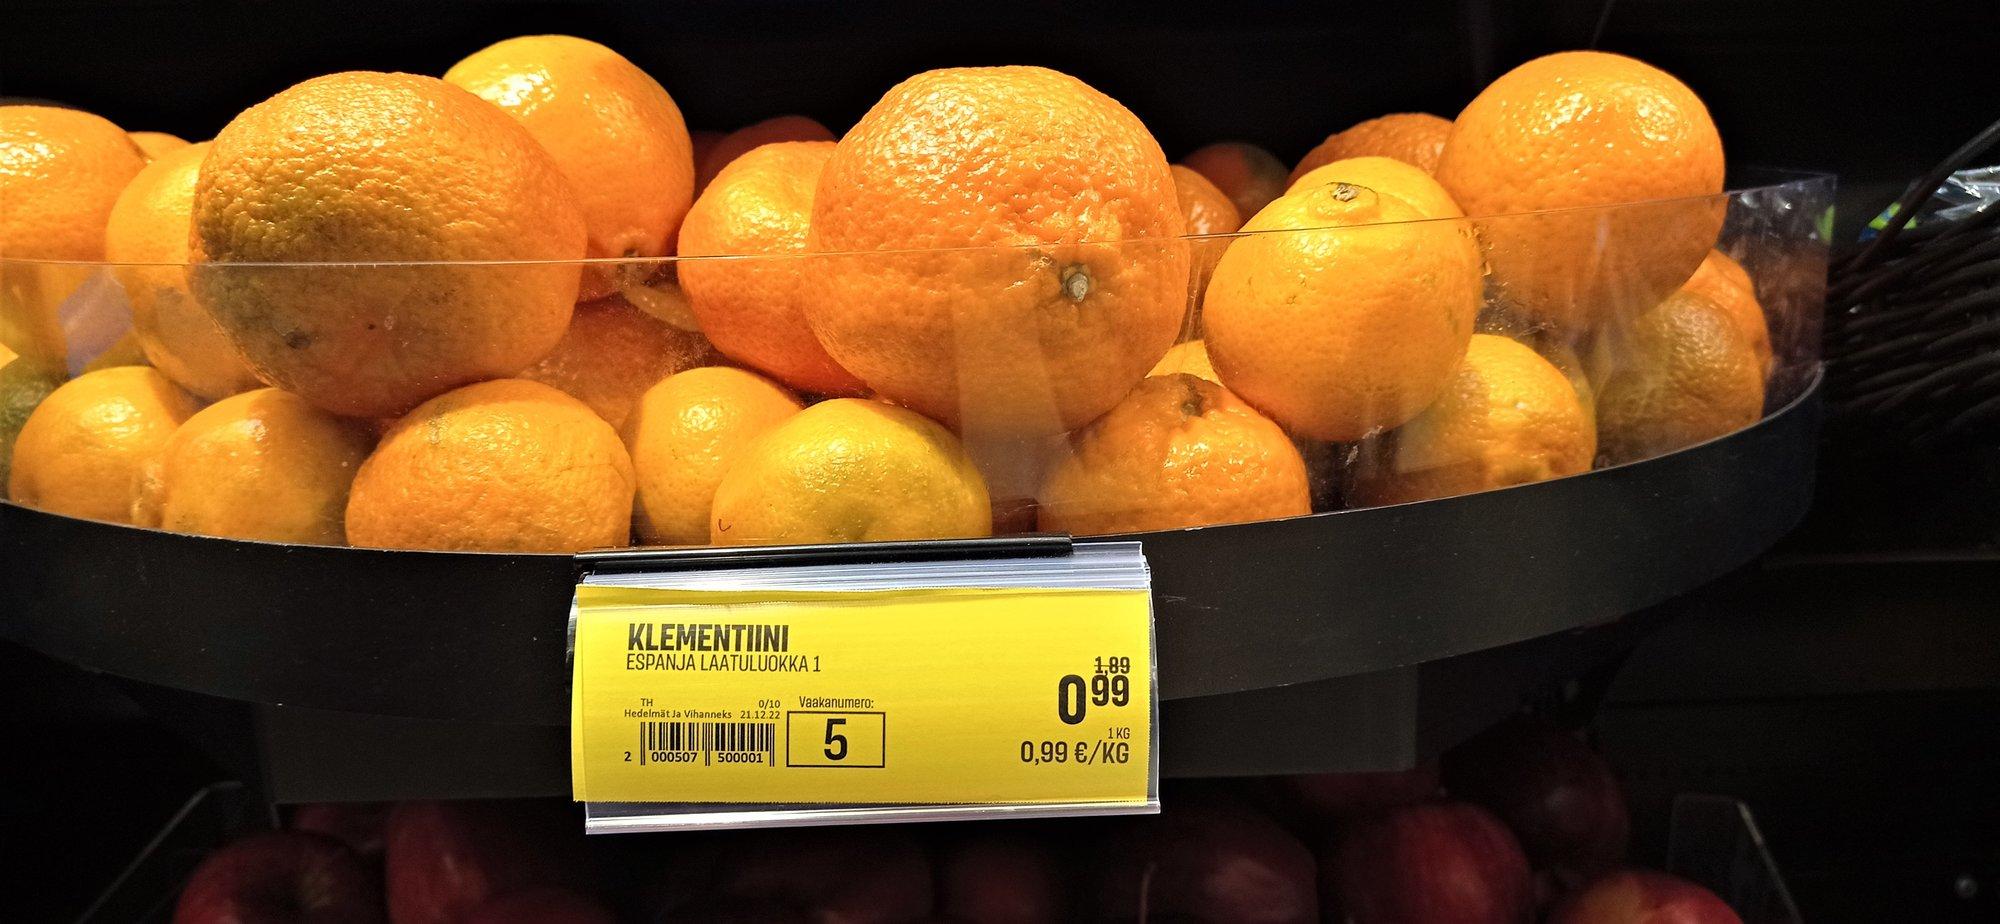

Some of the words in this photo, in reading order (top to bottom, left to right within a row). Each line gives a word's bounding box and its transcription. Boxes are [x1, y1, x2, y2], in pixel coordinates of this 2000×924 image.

[628, 623, 789, 652] KLEMENTIINI
[626, 654, 696, 671] ESPANJA
[700, 655, 809, 672] LAATULUOKKA
[812, 656, 821, 672] 1
[1094, 656, 1130, 676] 1,89
[640, 698, 653, 707] TH
[758, 700, 781, 709] 0/10
[799, 696, 874, 710] Vaakanumero:
[624, 709, 669, 719] Hedelmät
[672, 710, 681, 719] Ja
[684, 710, 732, 719] Vihanneks
[740, 711, 781, 719] 21.12.22
[824, 718, 848, 761] 5
[1108, 728, 1114, 739] 1
[1116, 727, 1130, 740] KG
[624, 752, 632, 762] 2
[651, 752, 698, 763] 000507
[717, 753, 764, 764] 500001
[1020, 741, 1068, 766] 0,99
[1074, 740, 1129, 765] €/KG
